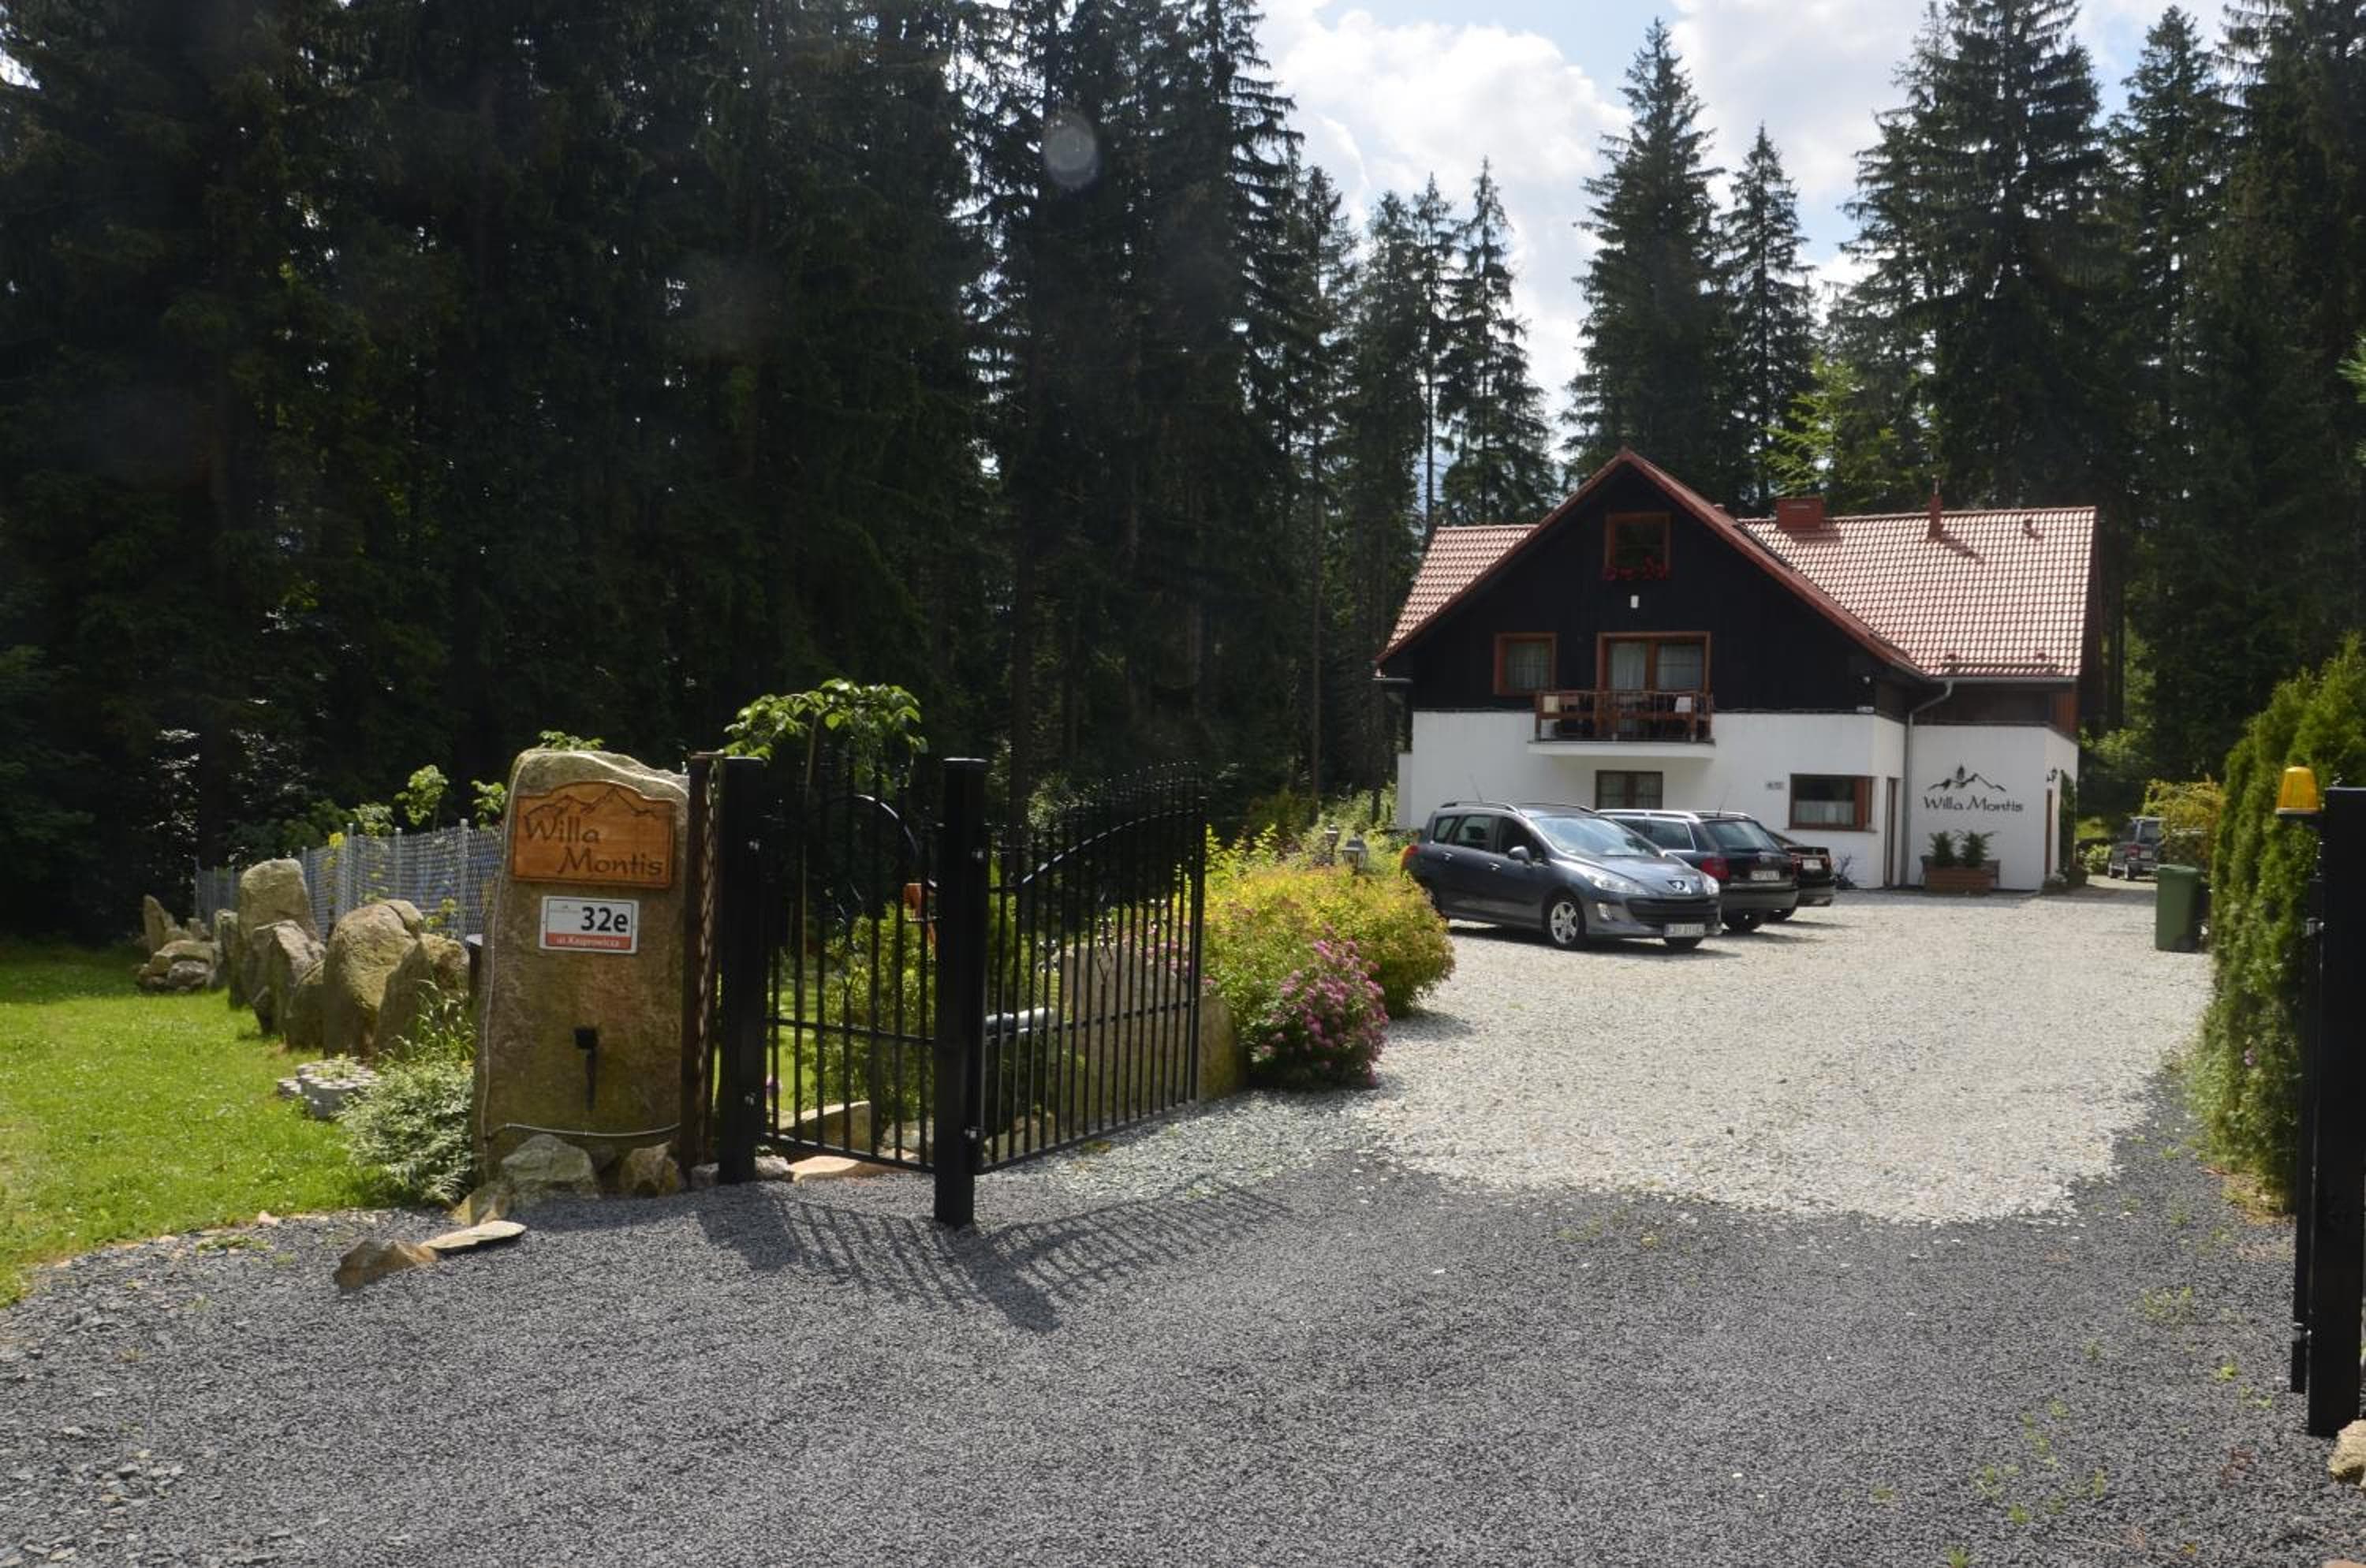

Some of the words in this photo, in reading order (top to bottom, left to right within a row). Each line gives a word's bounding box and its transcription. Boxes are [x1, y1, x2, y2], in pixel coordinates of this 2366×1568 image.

[1924, 796, 1963, 810] Willa
[1967, 796, 2024, 812] Montis
[523, 813, 599, 843] Willa
[558, 847, 663, 875] Montis
[581, 906, 629, 932] 32e
